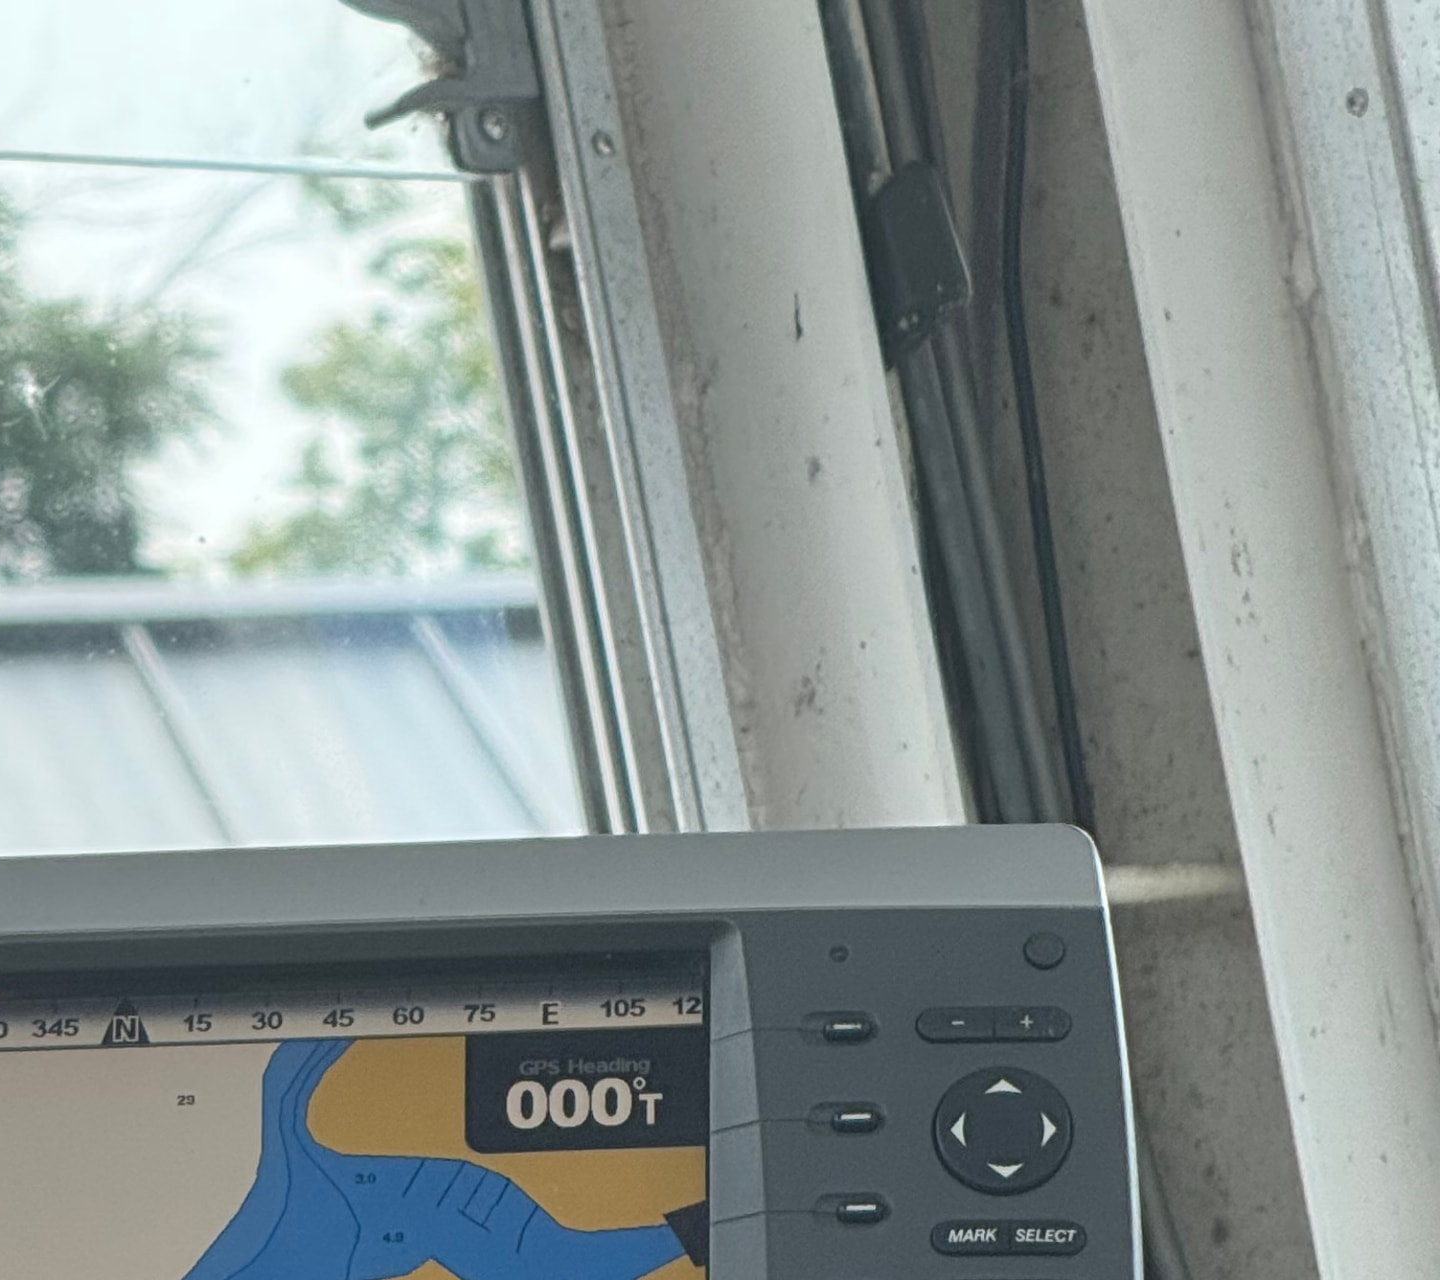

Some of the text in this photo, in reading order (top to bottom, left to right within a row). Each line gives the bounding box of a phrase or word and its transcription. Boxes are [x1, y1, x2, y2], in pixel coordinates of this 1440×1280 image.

[32, 1018, 79, 1039] 345
[113, 1016, 139, 1042] N
[184, 1014, 212, 1032] 15
[251, 1010, 283, 1030] 30
[322, 1008, 355, 1028] 45
[392, 1006, 425, 1026] 60
[464, 1003, 496, 1023] 75
[541, 1002, 560, 1025] E
[600, 998, 646, 1018] 105
[673, 996, 702, 1015] 12
[520, 1056, 650, 1077] GPS Heading
[177, 1095, 195, 1106] 29
[948, 1228, 1077, 1243] MARK SELECT
